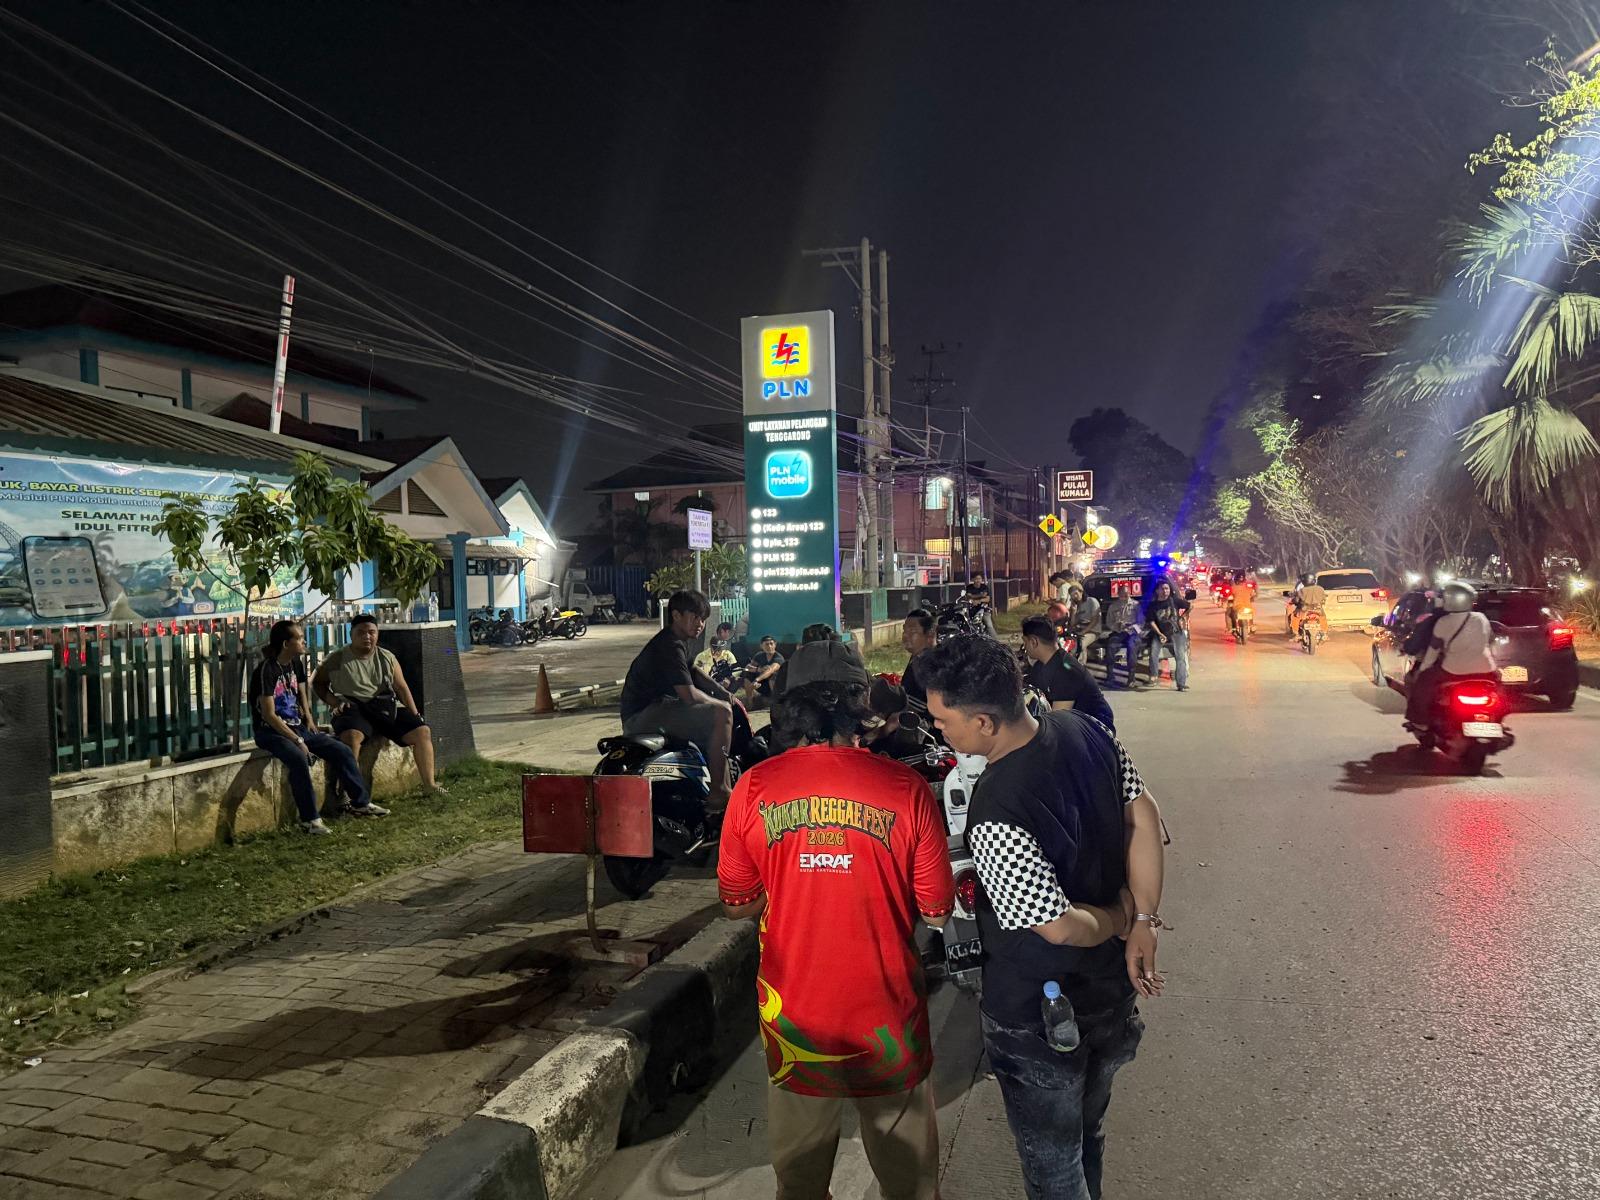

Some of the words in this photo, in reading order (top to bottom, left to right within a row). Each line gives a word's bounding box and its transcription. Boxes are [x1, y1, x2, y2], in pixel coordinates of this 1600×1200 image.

[763, 379, 810, 399] PLN
[749, 421, 763, 432] UNIT
[764, 420, 790, 431] LAYANAN
[791, 417, 827, 429] PELANGGAN
[765, 430, 811, 442] TENGGARONG
[770, 466, 790, 475] PLN
[771, 474, 806, 485] mobile
[1063, 481, 1087, 489] PULAU
[29, 482, 80, 493] BAYAR
[83, 485, 136, 496] LISTRIK
[1060, 488, 1090, 498] KUMALA
[0, 493, 46, 502] Melalui
[50, 495, 76, 504] PLN
[80, 496, 119, 505] Mobile
[120, 499, 149, 507] untuk
[61, 510, 137, 521] SELAMAT
[763, 508, 777, 517] 123
[75, 523, 113, 531] IDUL
[117, 524, 151, 532] FITR
[809, 521, 824, 531] 123
[763, 553, 779, 562] PLN
[781, 552, 795, 562] 123
[764, 582, 819, 592] www.pln.co.id
[759, 799, 814, 849] KUKAR
[808, 795, 863, 828] REGGAE
[863, 804, 896, 852] FEST
[807, 830, 845, 846] 2026
[800, 853, 853, 869] EKRAF
